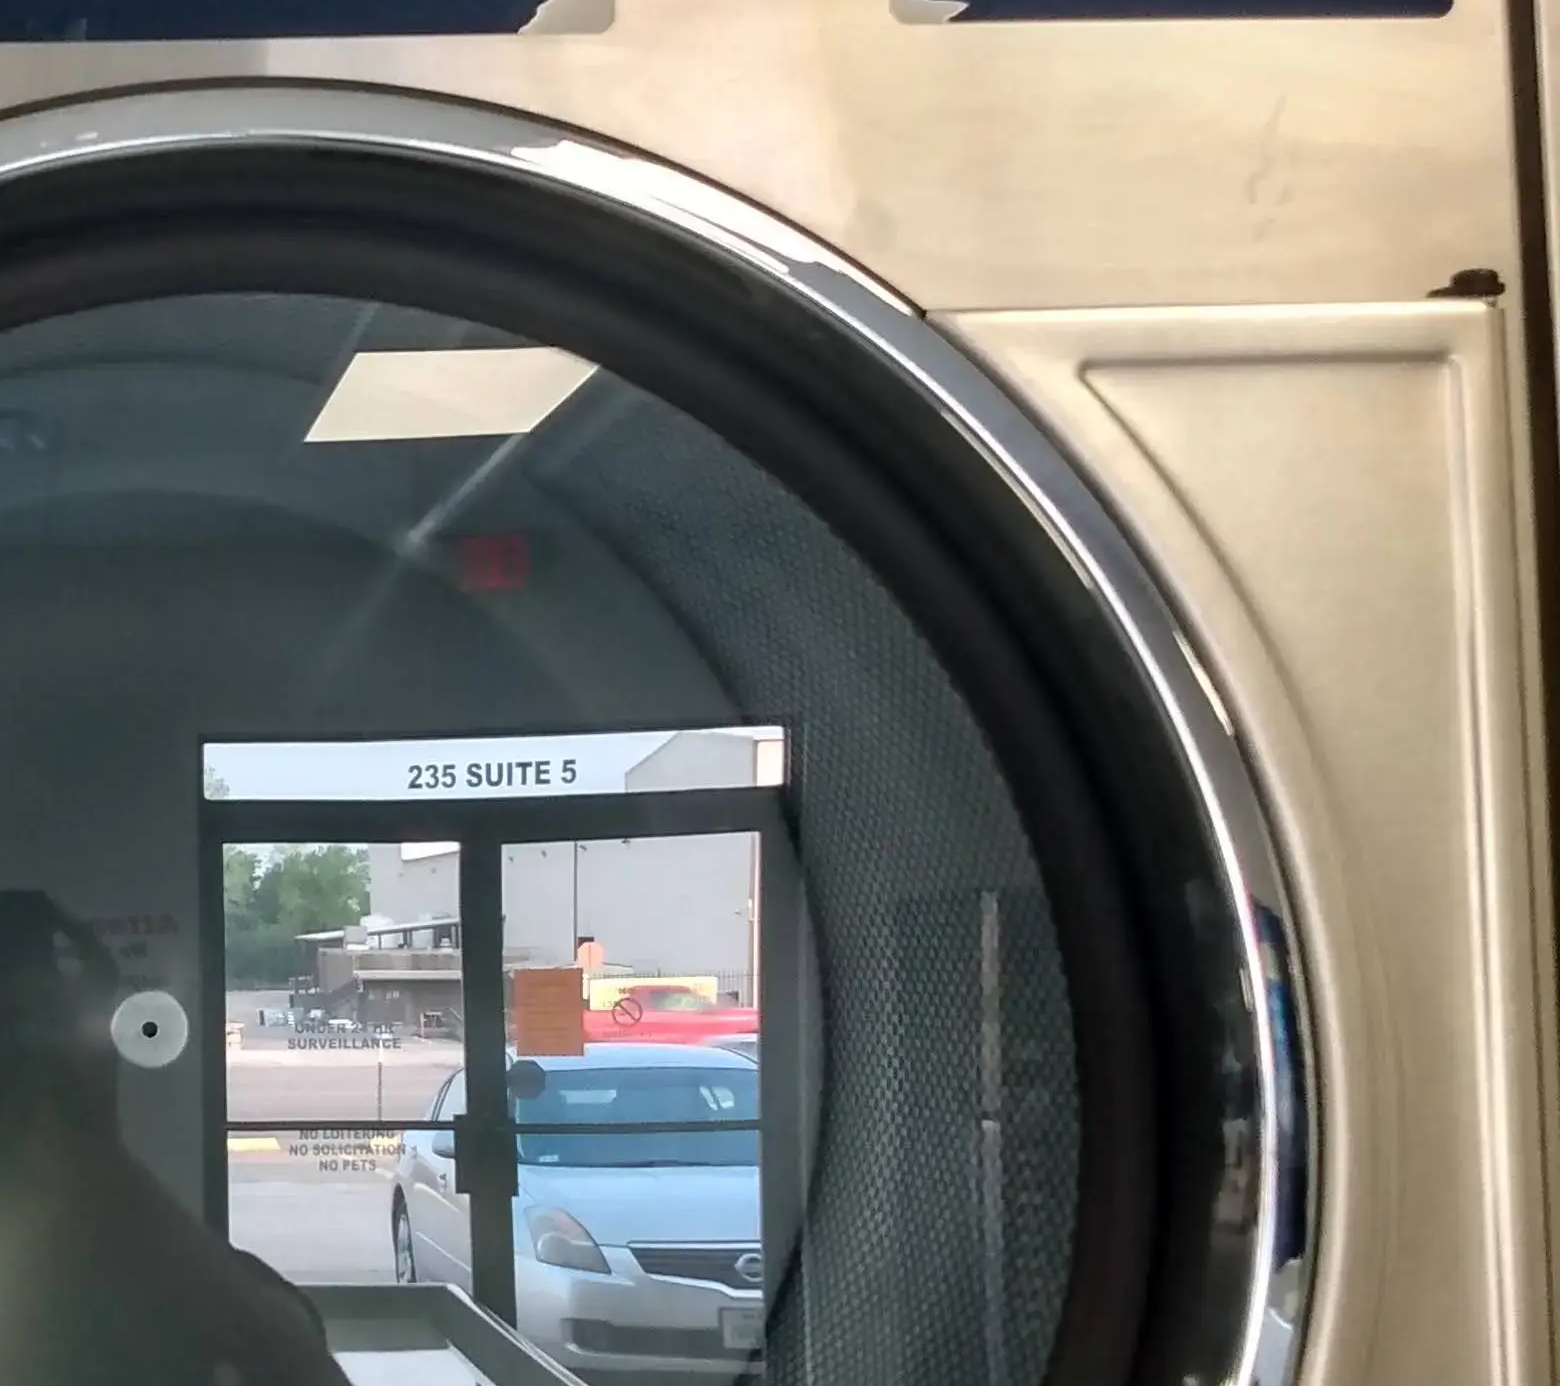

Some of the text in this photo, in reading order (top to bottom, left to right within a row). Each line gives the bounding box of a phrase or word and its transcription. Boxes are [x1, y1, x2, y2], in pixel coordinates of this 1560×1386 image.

[407, 758, 577, 789] 235 SUITE 5
[294, 1021, 346, 1034] UNDER
[288, 1037, 402, 1050] SURVEILLANCE
[299, 1128, 318, 1140] NO
[290, 1143, 406, 1156] NO SOLICITATION
[319, 1159, 377, 1171] NO PETS
